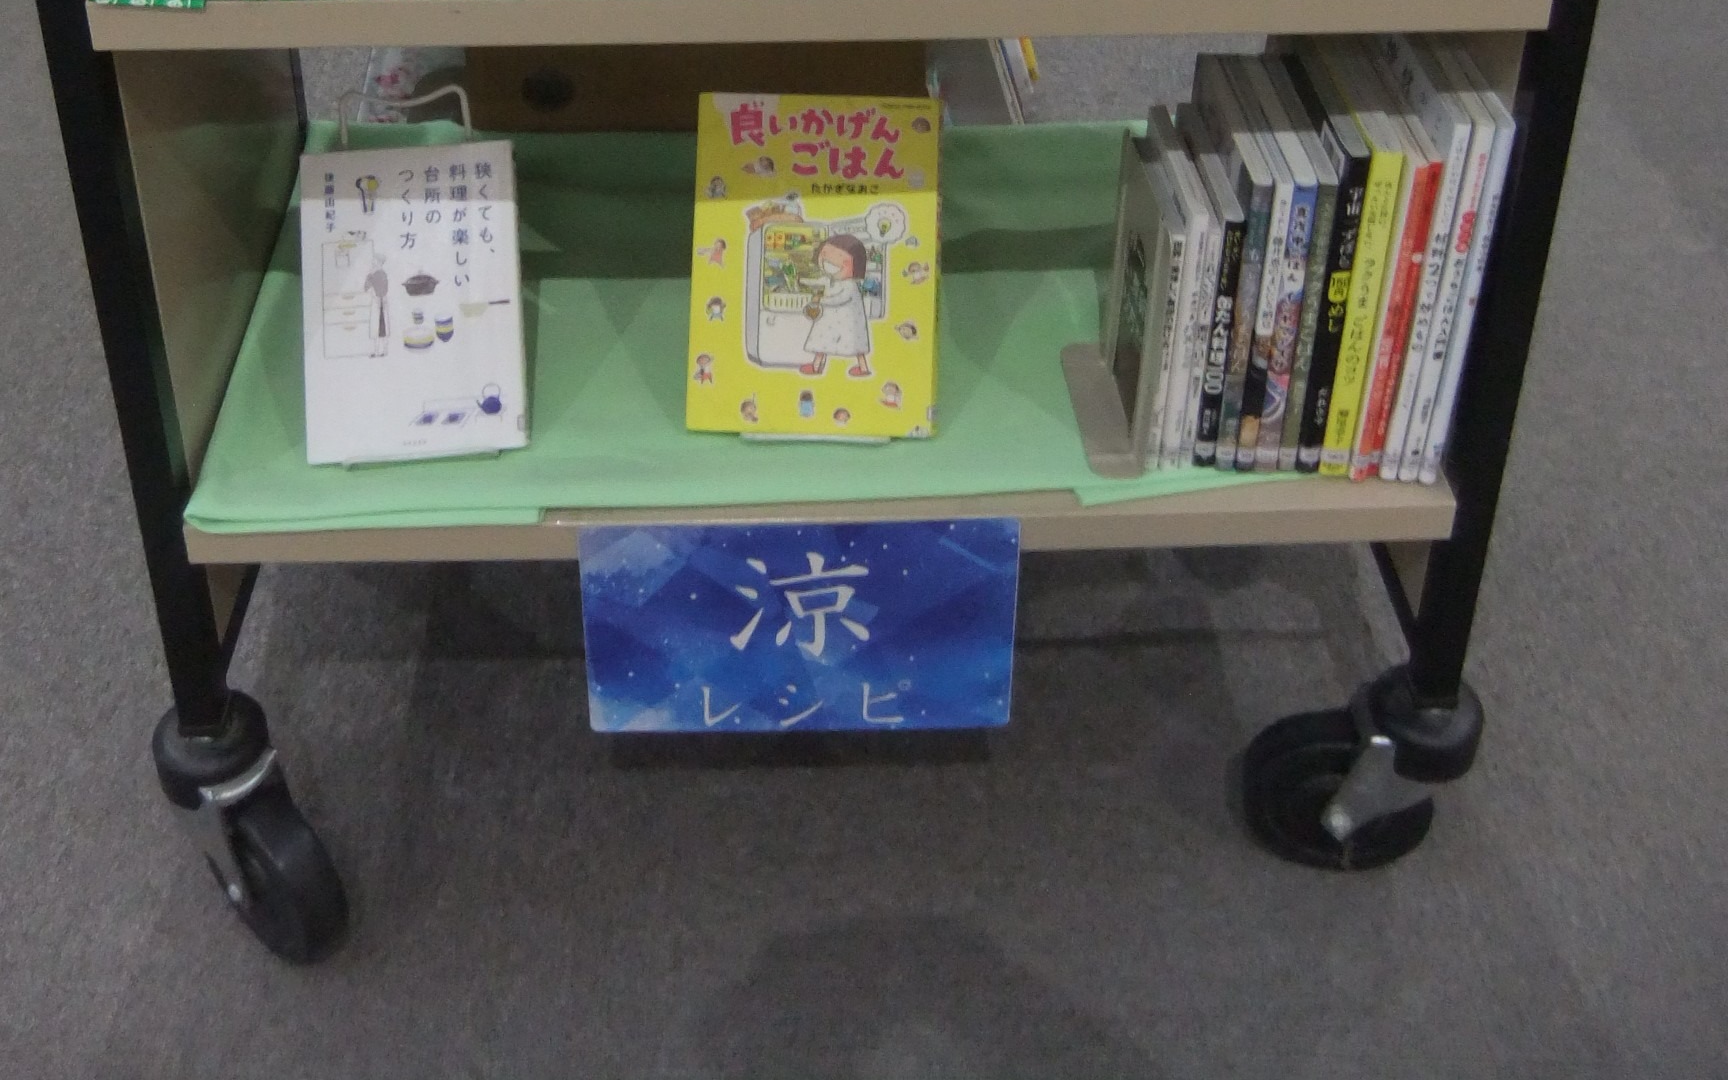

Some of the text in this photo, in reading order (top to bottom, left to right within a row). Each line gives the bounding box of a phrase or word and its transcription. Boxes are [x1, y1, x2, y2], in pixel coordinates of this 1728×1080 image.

[730, 102, 901, 147] 良いかげん
[423, 165, 442, 225] 台所の
[792, 141, 905, 180] ごはん
[397, 168, 417, 250] つくり方
[449, 162, 470, 288] 料理が楽しい
[474, 162, 506, 254] 狭くても、
[729, 551, 871, 658] 涼
[701, 681, 914, 728] レシピ
